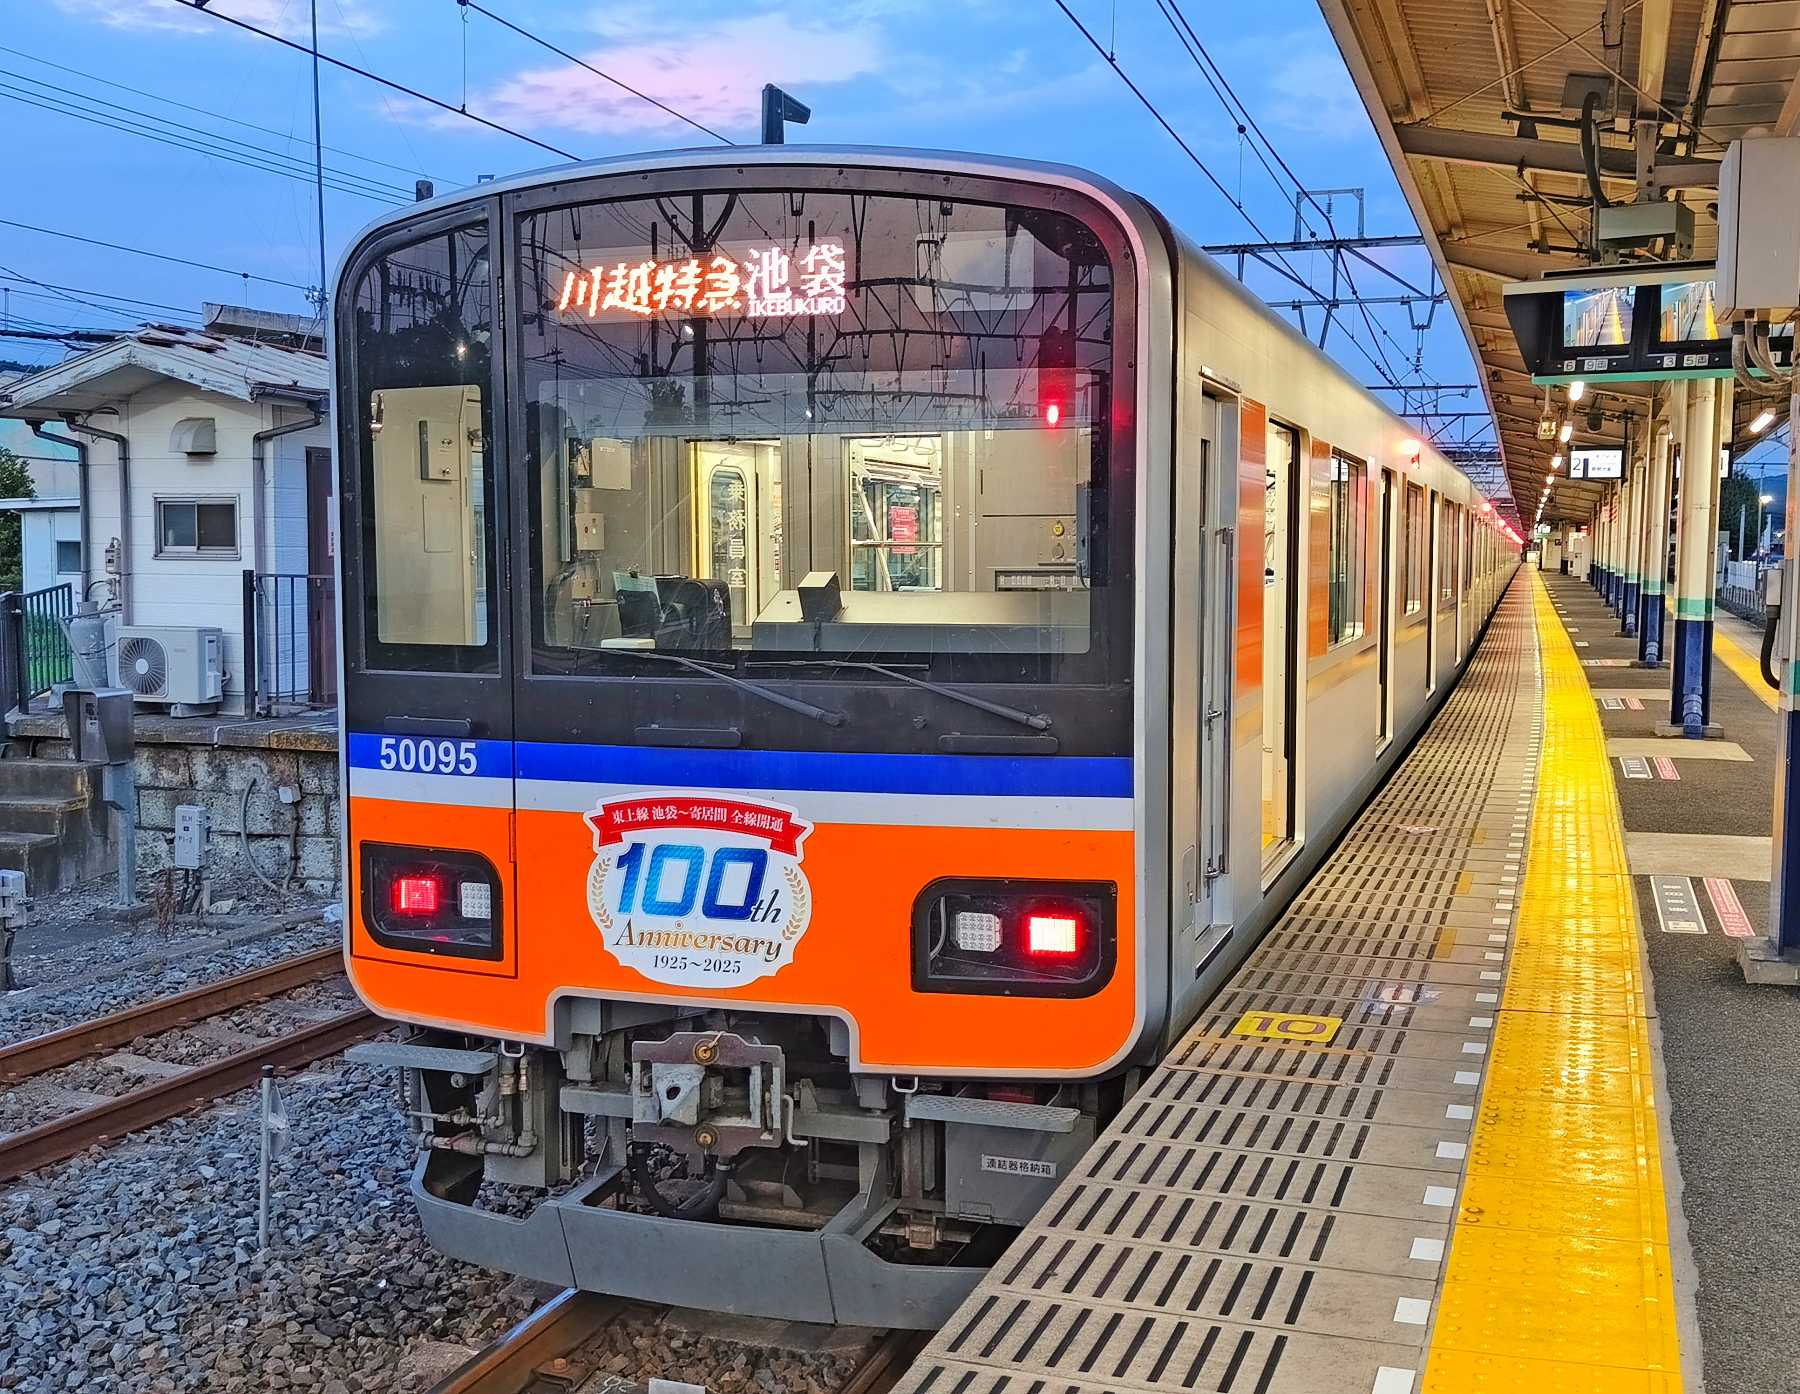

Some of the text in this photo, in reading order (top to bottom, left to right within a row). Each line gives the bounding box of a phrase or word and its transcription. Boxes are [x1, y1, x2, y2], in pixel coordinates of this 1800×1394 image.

[559, 244, 845, 316] 川越特急 池袋
[750, 296, 845, 316] IKEBUKURO
[1572, 457, 1582, 471] 2
[380, 738, 477, 774] 50095
[612, 808, 649, 824] 東上線
[730, 809, 783, 833] 全線開通
[613, 919, 782, 962] Anniversary
